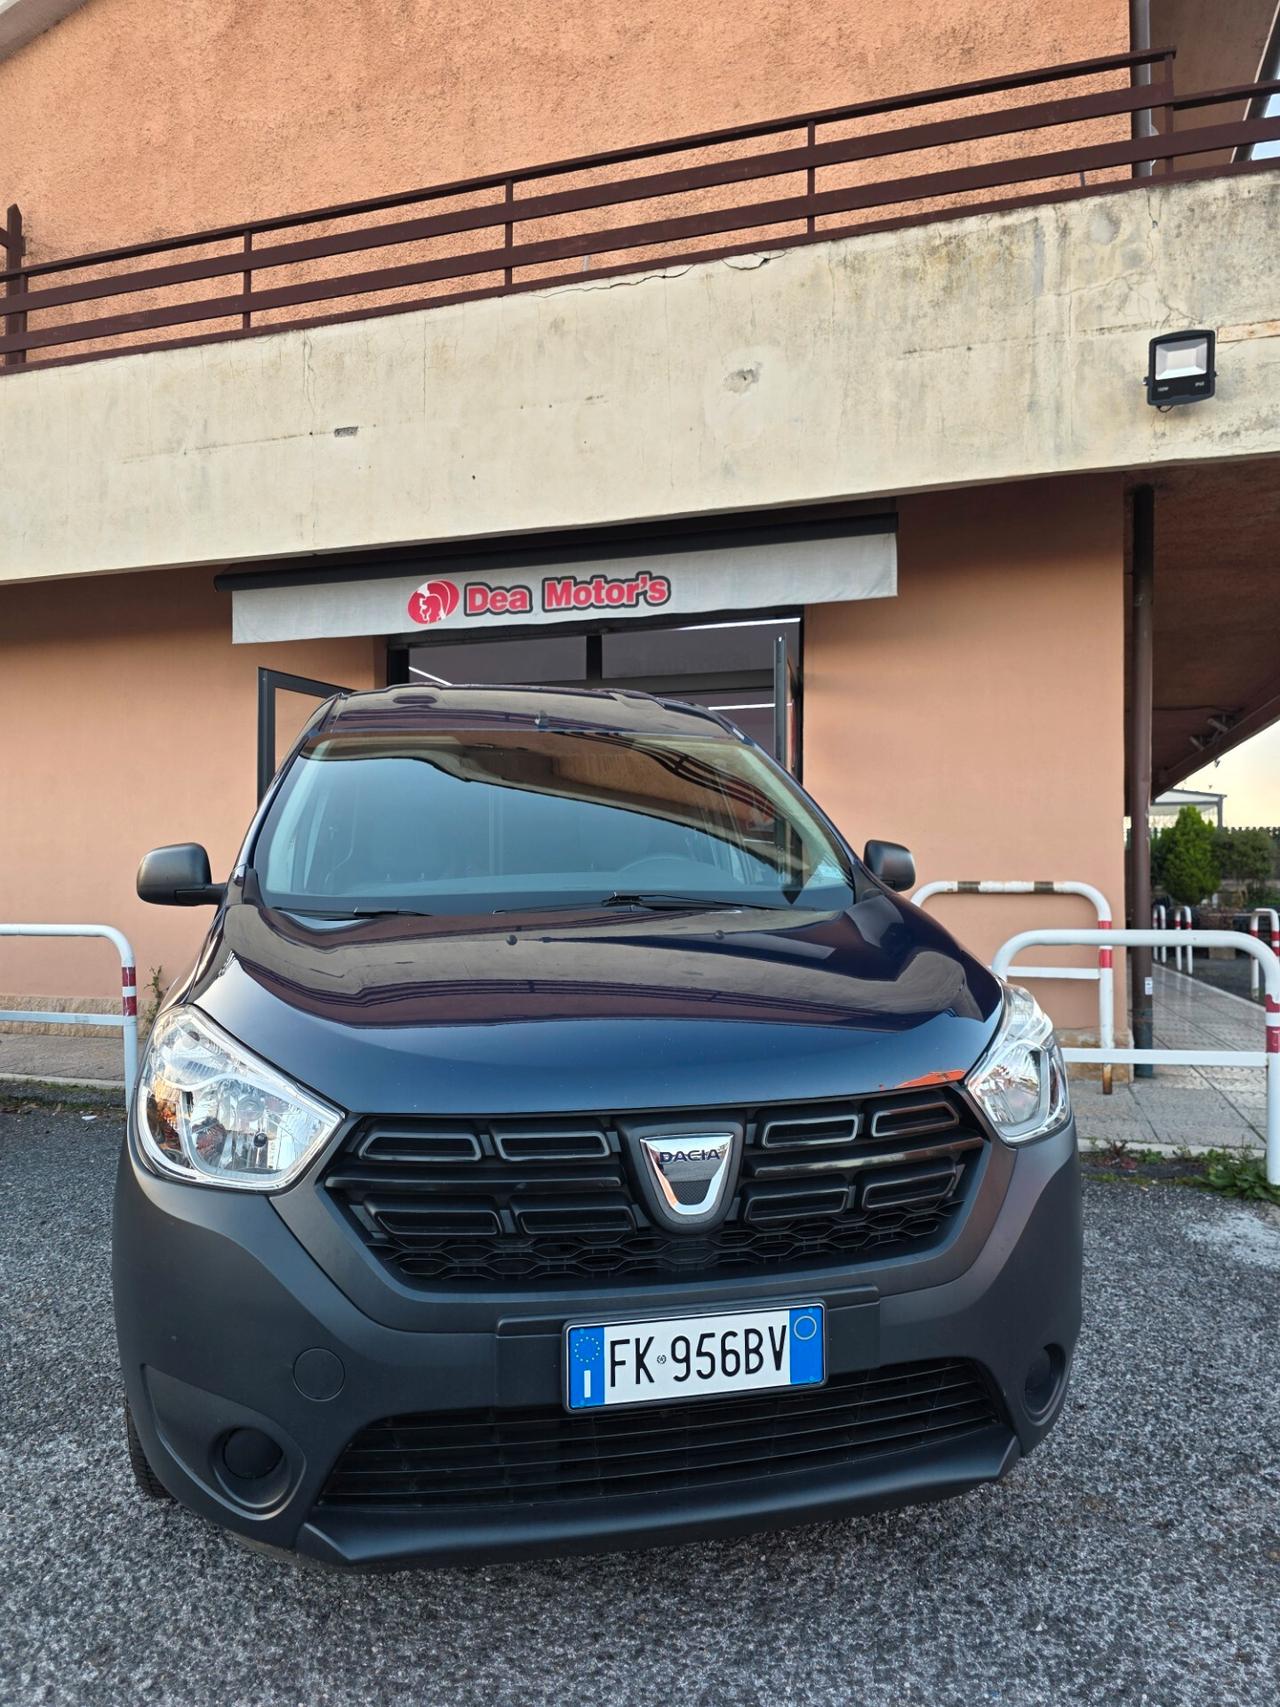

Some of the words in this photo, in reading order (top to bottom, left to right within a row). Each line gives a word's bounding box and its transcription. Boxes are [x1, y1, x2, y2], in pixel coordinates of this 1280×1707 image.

[465, 583, 531, 616] Dea
[543, 571, 670, 612] Motor's
[660, 1149, 720, 1162] DACIA
